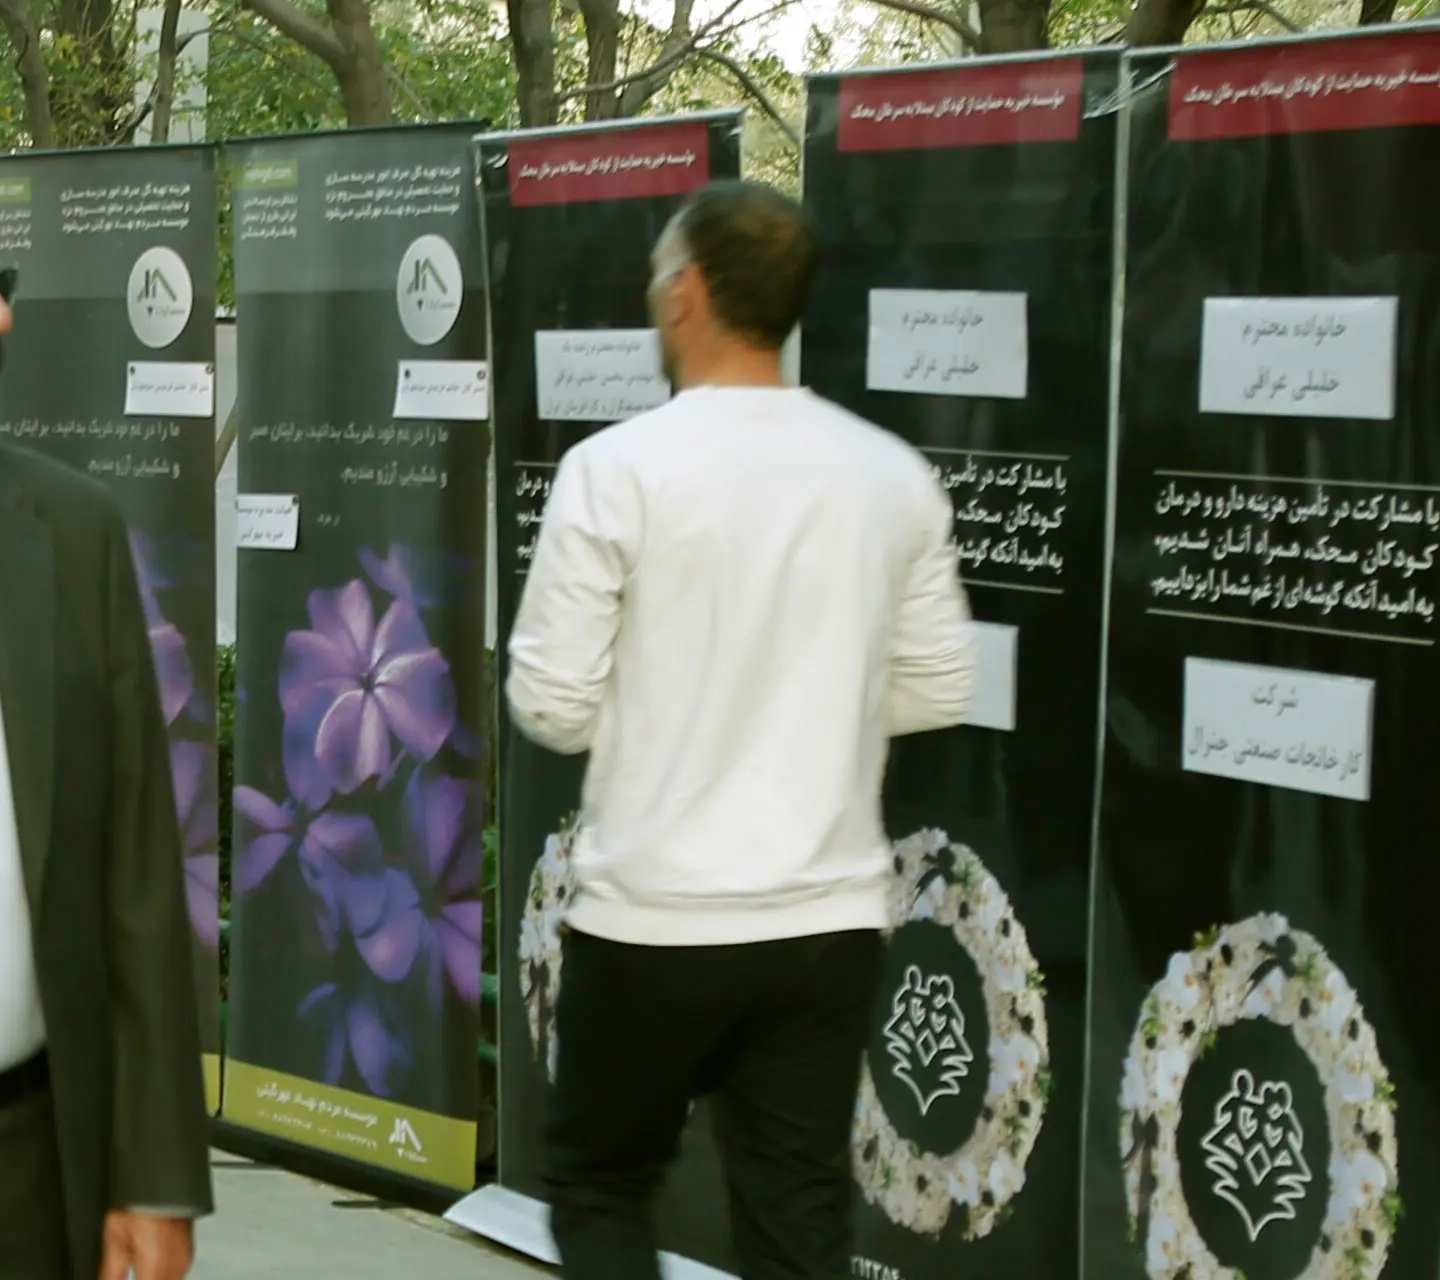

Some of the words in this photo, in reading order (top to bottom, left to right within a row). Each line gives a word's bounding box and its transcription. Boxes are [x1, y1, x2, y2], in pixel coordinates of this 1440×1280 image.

[1243, 320, 1287, 344] محترم
[1294, 314, 1347, 347] خانواده
[1243, 366, 1287, 399] عراقی
[1293, 369, 1340, 400] خلیلی
[977, 469, 994, 491] در
[996, 462, 1053, 494] مشارکت
[1055, 466, 1067, 495] با
[1155, 482, 1201, 516] درمان
[1202, 496, 1213, 517] و
[1213, 485, 1245, 519] دارو
[1246, 495, 1286, 521] هزینه
[1328, 501, 1349, 528] در
[1351, 494, 1423, 531] مشارکت
[1425, 499, 1440, 531] با
[1004, 503, 1066, 536] کودکان
[1212, 524, 1252, 560] آنان
[1254, 530, 1300, 565] همراه
[1361, 540, 1439, 578] کودکان
[1209, 567, 1221, 602] را
[1222, 570, 1251, 595] شما
[1250, 575, 1272, 606] غم
[1271, 575, 1286, 609] از
[1343, 579, 1378, 610] آنکه
[1377, 587, 1416, 618] امید
[1415, 597, 1434, 623] به
[1252, 683, 1297, 716] شرکت
